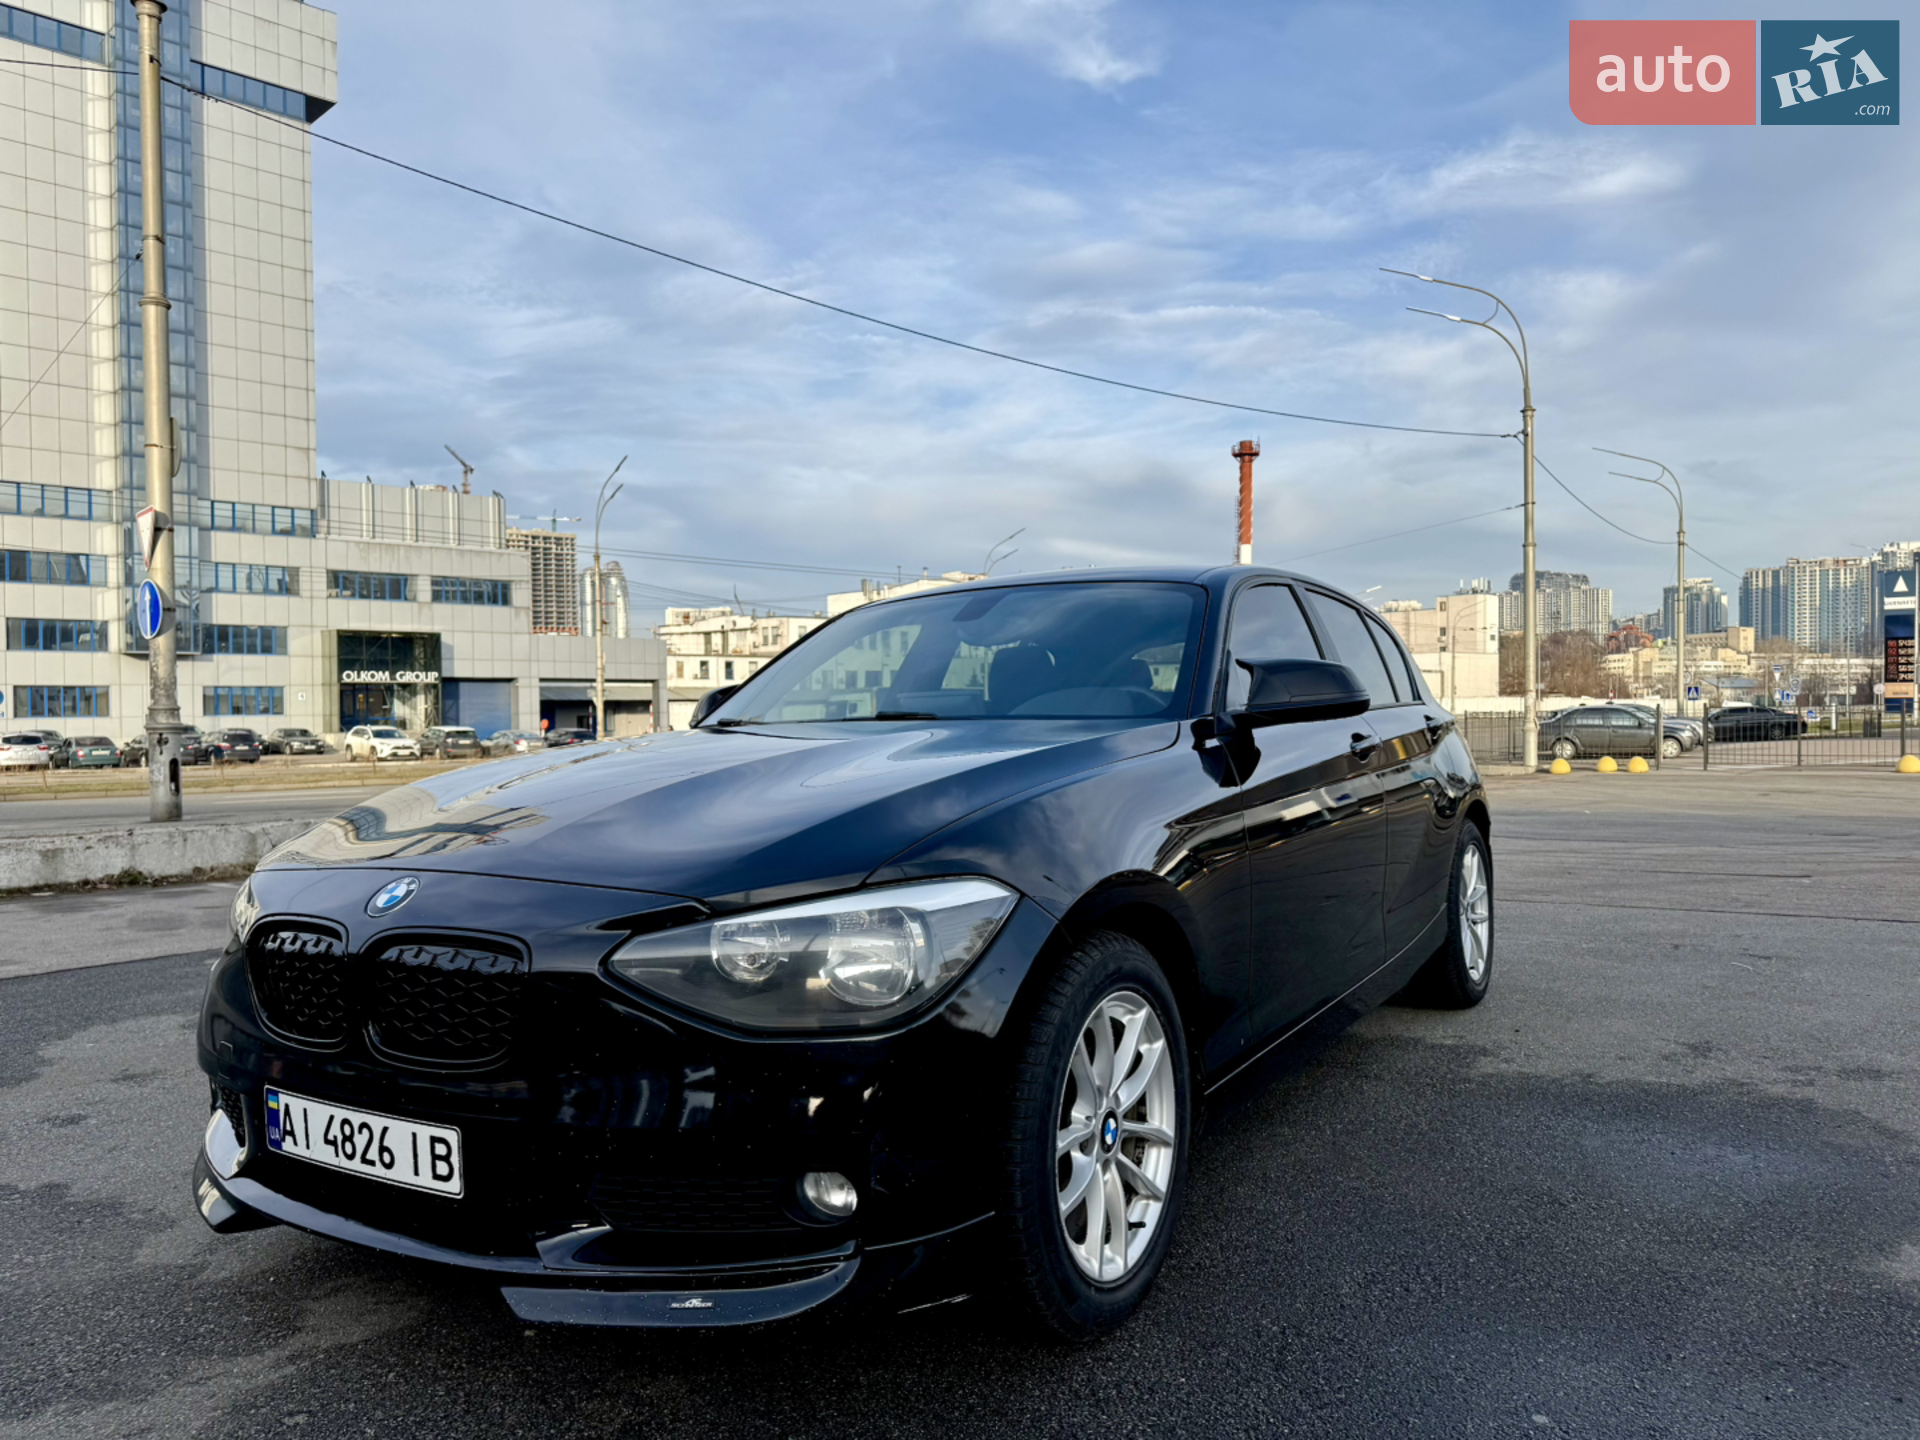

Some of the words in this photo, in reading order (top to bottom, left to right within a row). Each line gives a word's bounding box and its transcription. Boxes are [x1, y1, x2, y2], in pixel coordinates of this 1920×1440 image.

[342, 670, 390, 681] OLKOM
[395, 671, 439, 681] GROUP
[268, 1126, 281, 1141] UA
[281, 1102, 310, 1150] AI
[323, 1114, 396, 1170] 4826
[411, 1131, 454, 1183] IB
